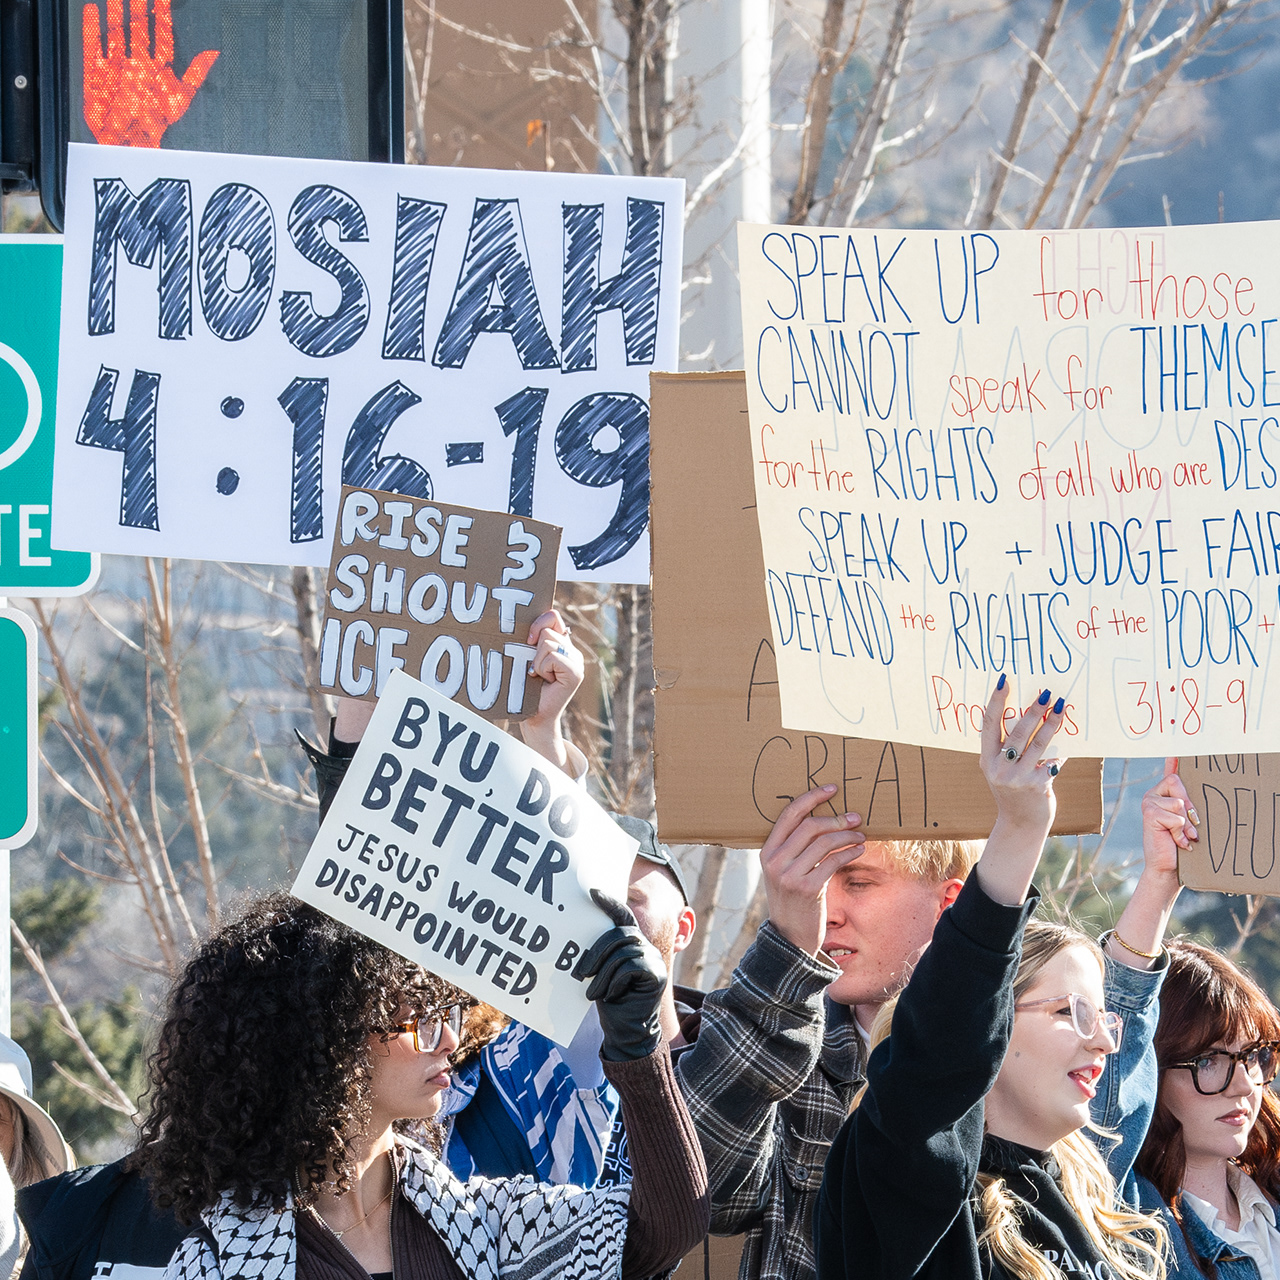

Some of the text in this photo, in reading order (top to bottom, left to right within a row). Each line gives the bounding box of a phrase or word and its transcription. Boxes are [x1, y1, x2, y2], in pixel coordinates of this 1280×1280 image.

[88, 178, 665, 373] MOSIAH
[761, 232, 912, 324] SPEAK
[934, 232, 1000, 324] UP
[1033, 236, 1104, 322] for
[1129, 240, 1255, 320] those
[757, 325, 921, 421] CANNOT
[948, 362, 1047, 423] speak
[1063, 354, 1113, 411] for
[865, 426, 998, 504] RIGHTS
[1110, 449, 1162, 494] who
[1173, 461, 1212, 487] are
[340, 490, 475, 569] RISE
[798, 506, 911, 583] SPEAK
[921, 518, 968, 585] UP
[1005, 541, 1032, 565] +
[1049, 517, 1179, 586] JUDGE
[329, 553, 535, 634] SHOUT
[767, 568, 894, 666] DEFEND
[900, 603, 936, 631] the
[949, 590, 1072, 675] RIGHTS
[1076, 605, 1101, 639] of
[1108, 608, 1149, 636] the
[1161, 587, 1259, 669] POOR
[1258, 614, 1276, 633] +
[320, 617, 539, 715] ICE OUT
[931, 674, 1247, 737] Proers 31:8-9
[391, 697, 580, 839] BYU, DO
[361, 752, 571, 912] BETTER.
[314, 858, 538, 1006] DISAPPOINTED.
[337, 822, 440, 893] JESUS
[447, 880, 551, 954] WOULD
